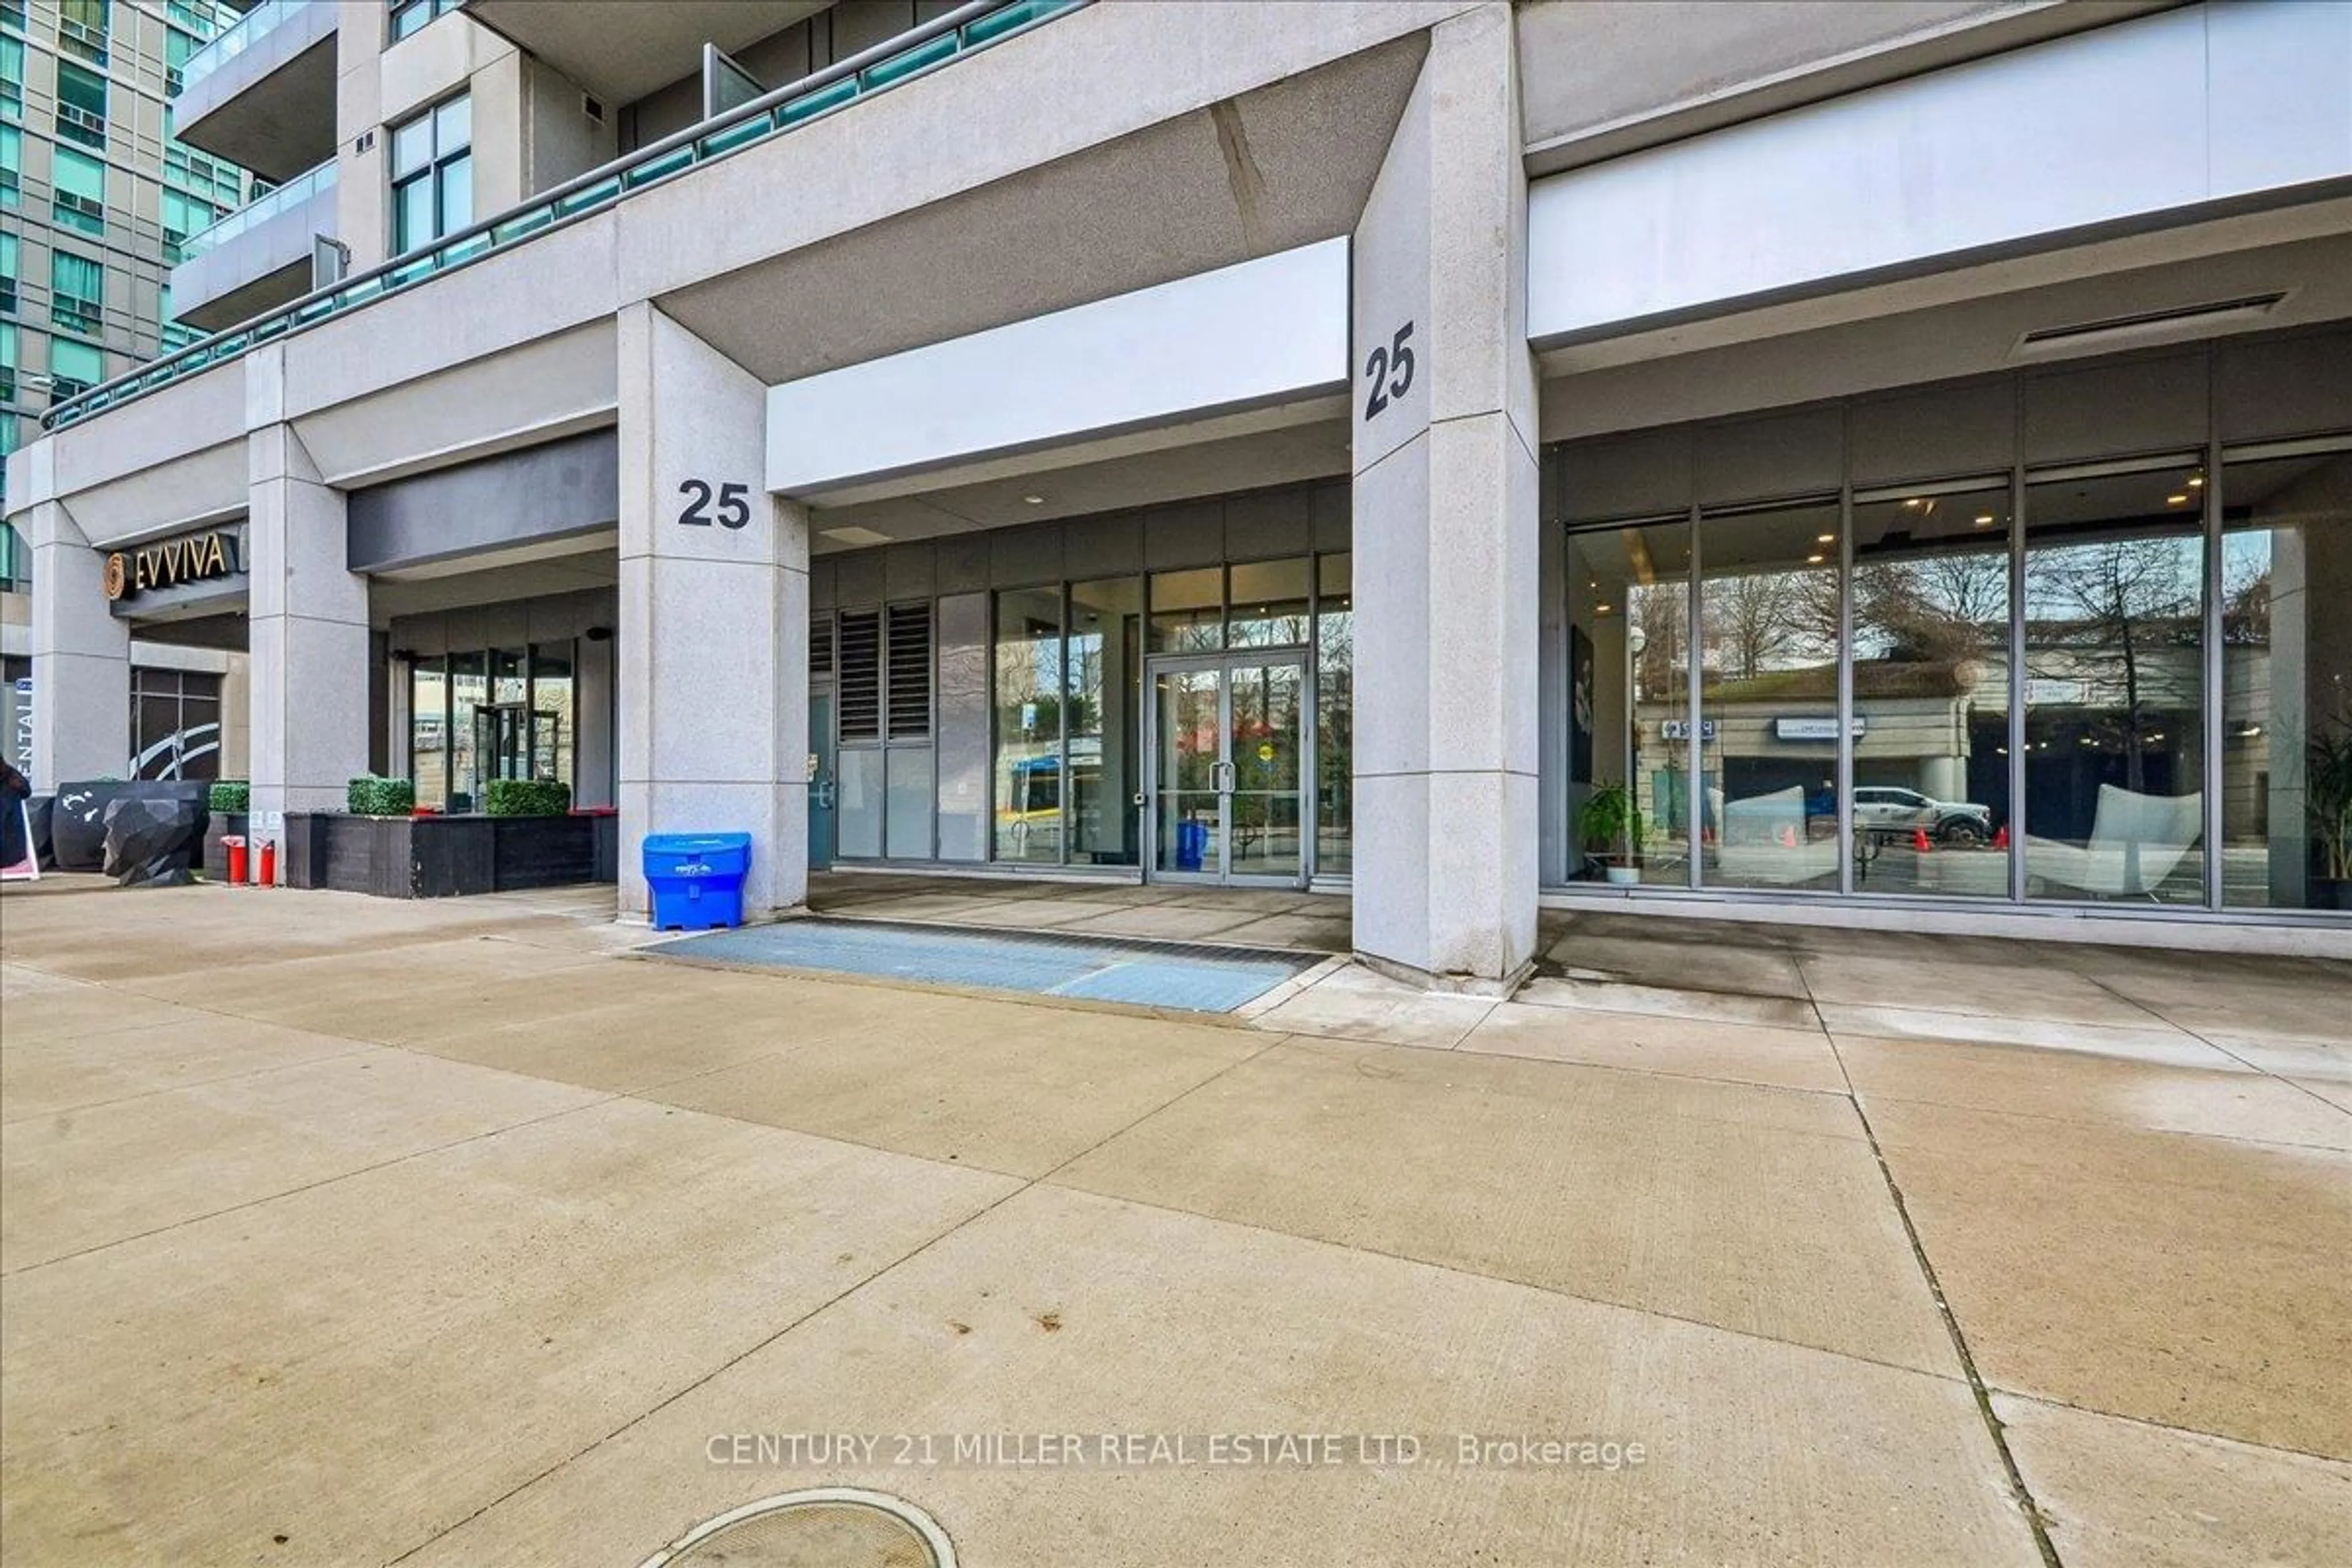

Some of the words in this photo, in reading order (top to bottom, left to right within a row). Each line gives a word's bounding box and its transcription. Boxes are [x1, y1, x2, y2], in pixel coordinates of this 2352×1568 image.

[1365, 320, 1414, 422] 25
[678, 478, 750, 530] 25
[135, 532, 226, 589] EVVIVA
[17, 704, 32, 778] ENTAL
